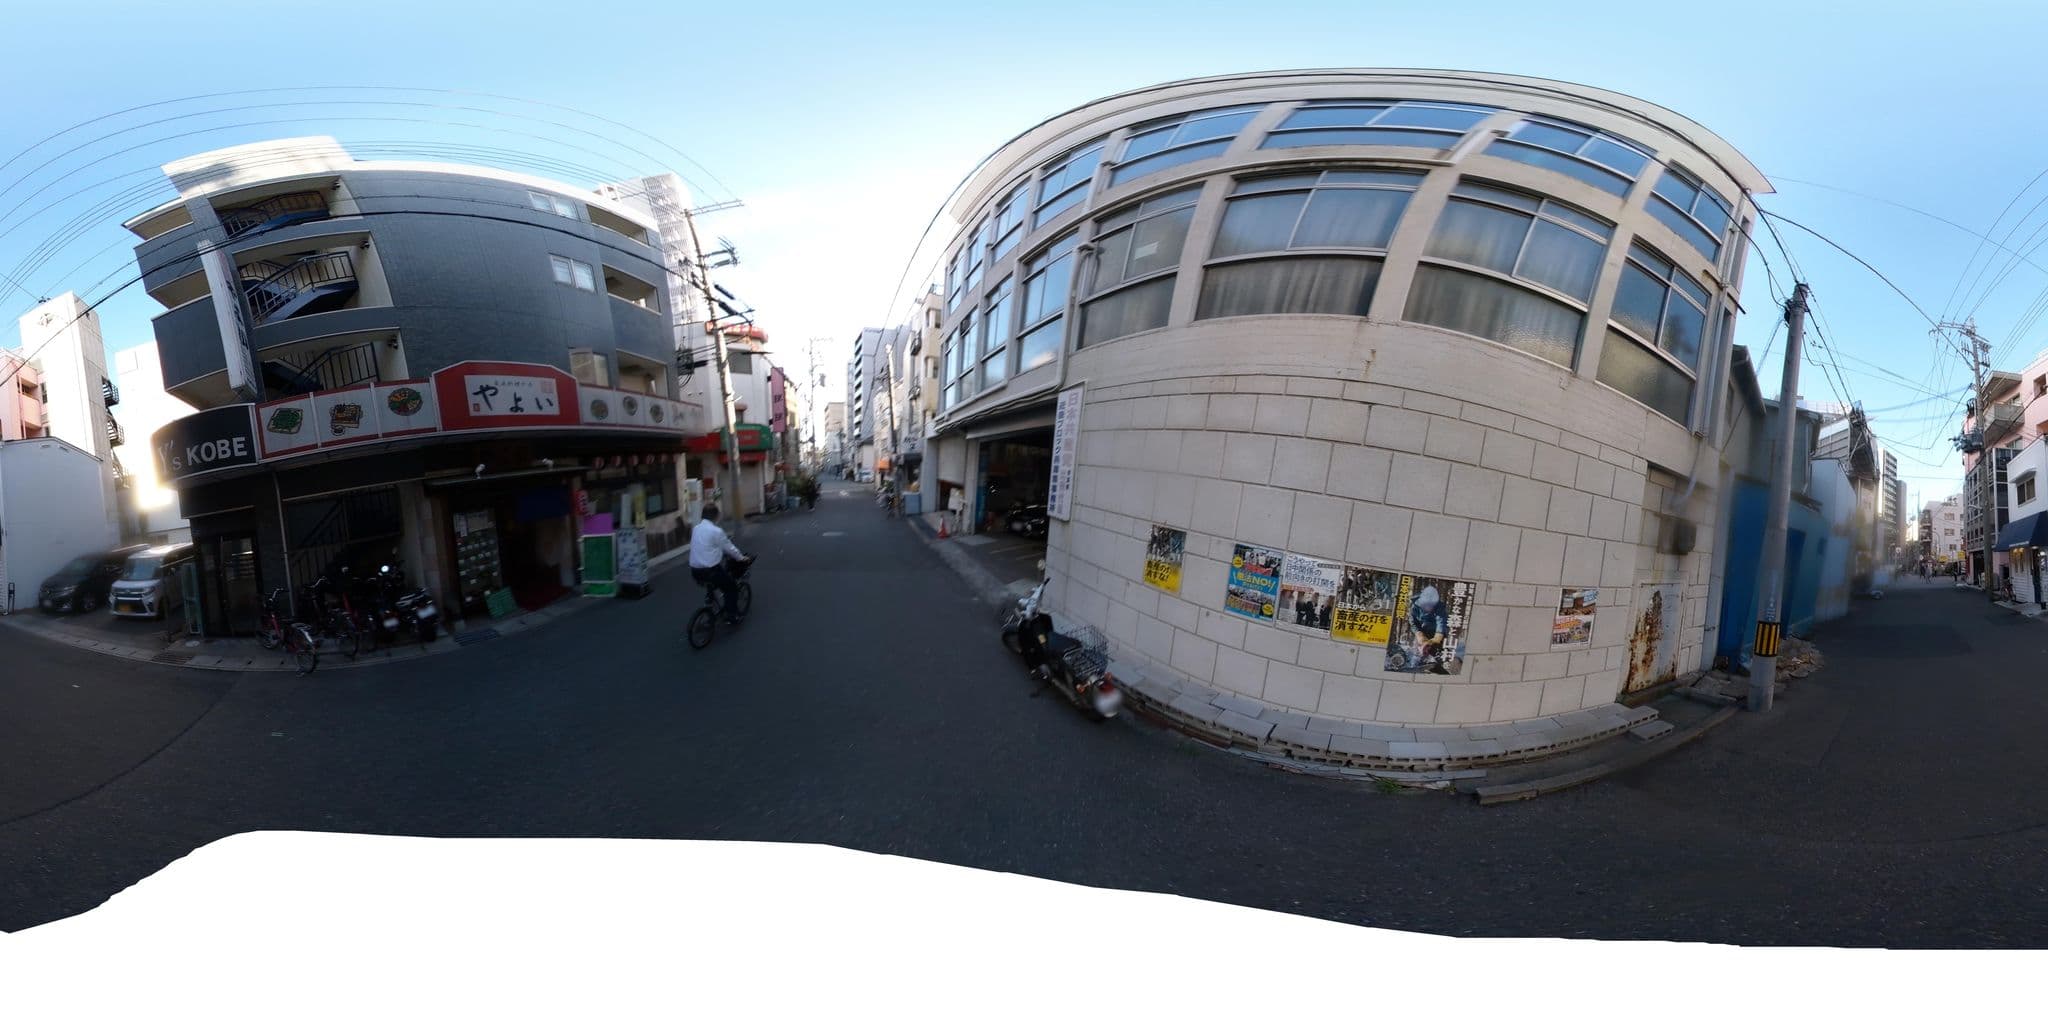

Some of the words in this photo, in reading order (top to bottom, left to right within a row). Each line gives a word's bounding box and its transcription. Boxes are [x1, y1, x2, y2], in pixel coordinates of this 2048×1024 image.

[472, 384, 554, 413] やよい
[186, 436, 248, 466] KOBE
